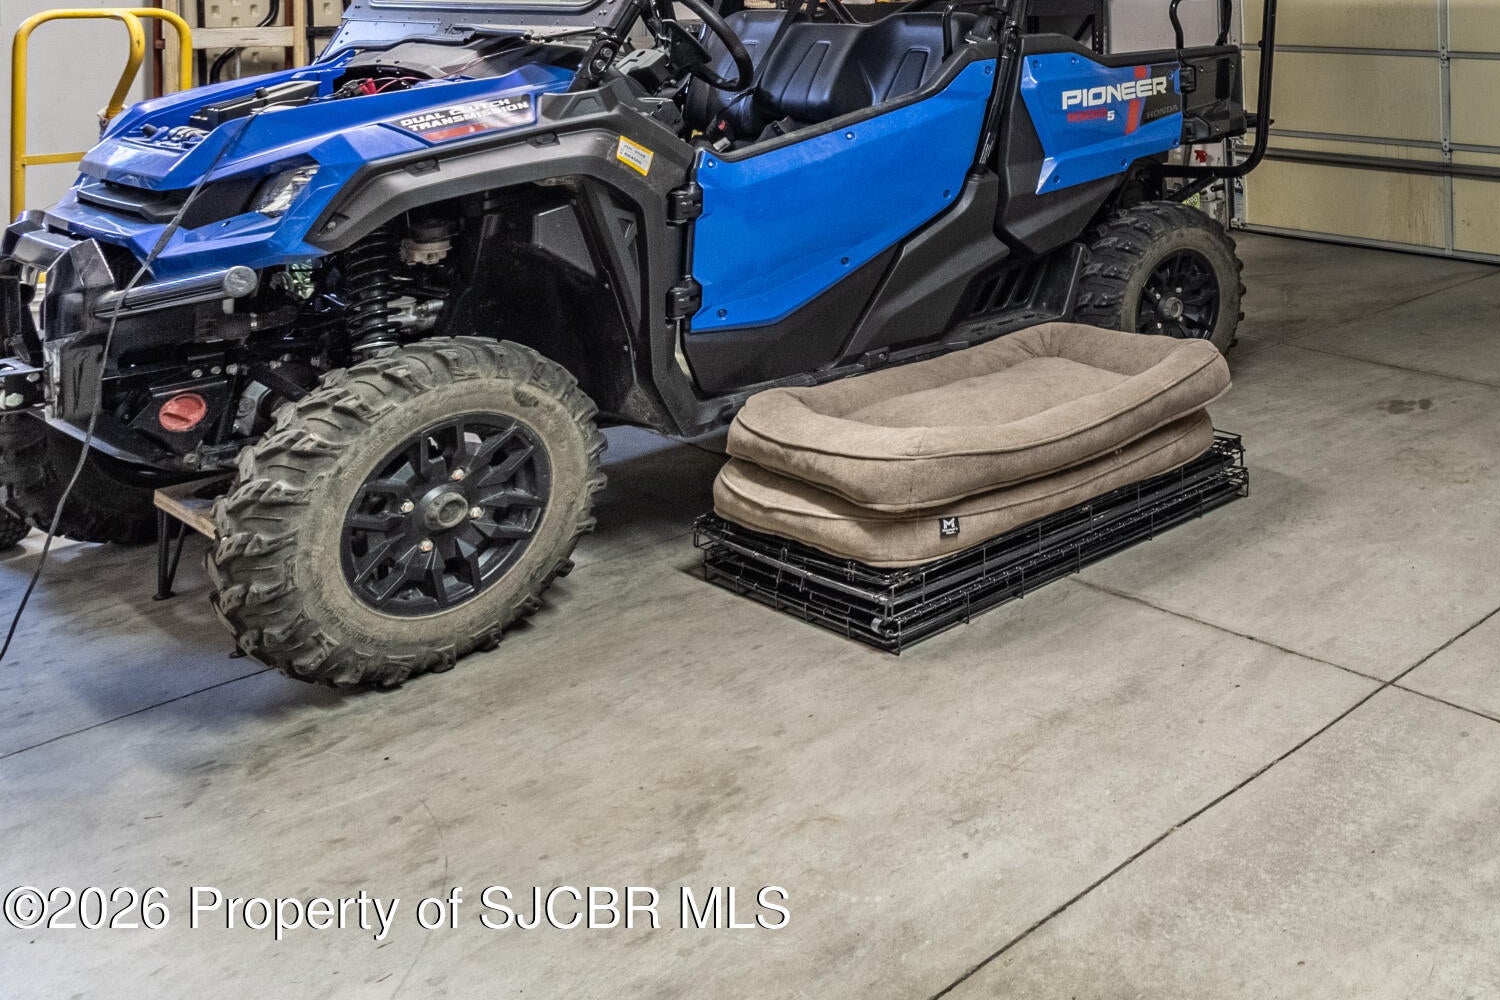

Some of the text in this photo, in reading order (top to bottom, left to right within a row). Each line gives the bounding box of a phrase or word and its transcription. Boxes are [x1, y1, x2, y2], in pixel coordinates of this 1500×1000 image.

[1061, 76, 1167, 110] PIONEER
[400, 98, 511, 127] DUAL CLUTCH
[408, 101, 530, 131] TRANSMISSION
[1146, 103, 1179, 119] HONDA
